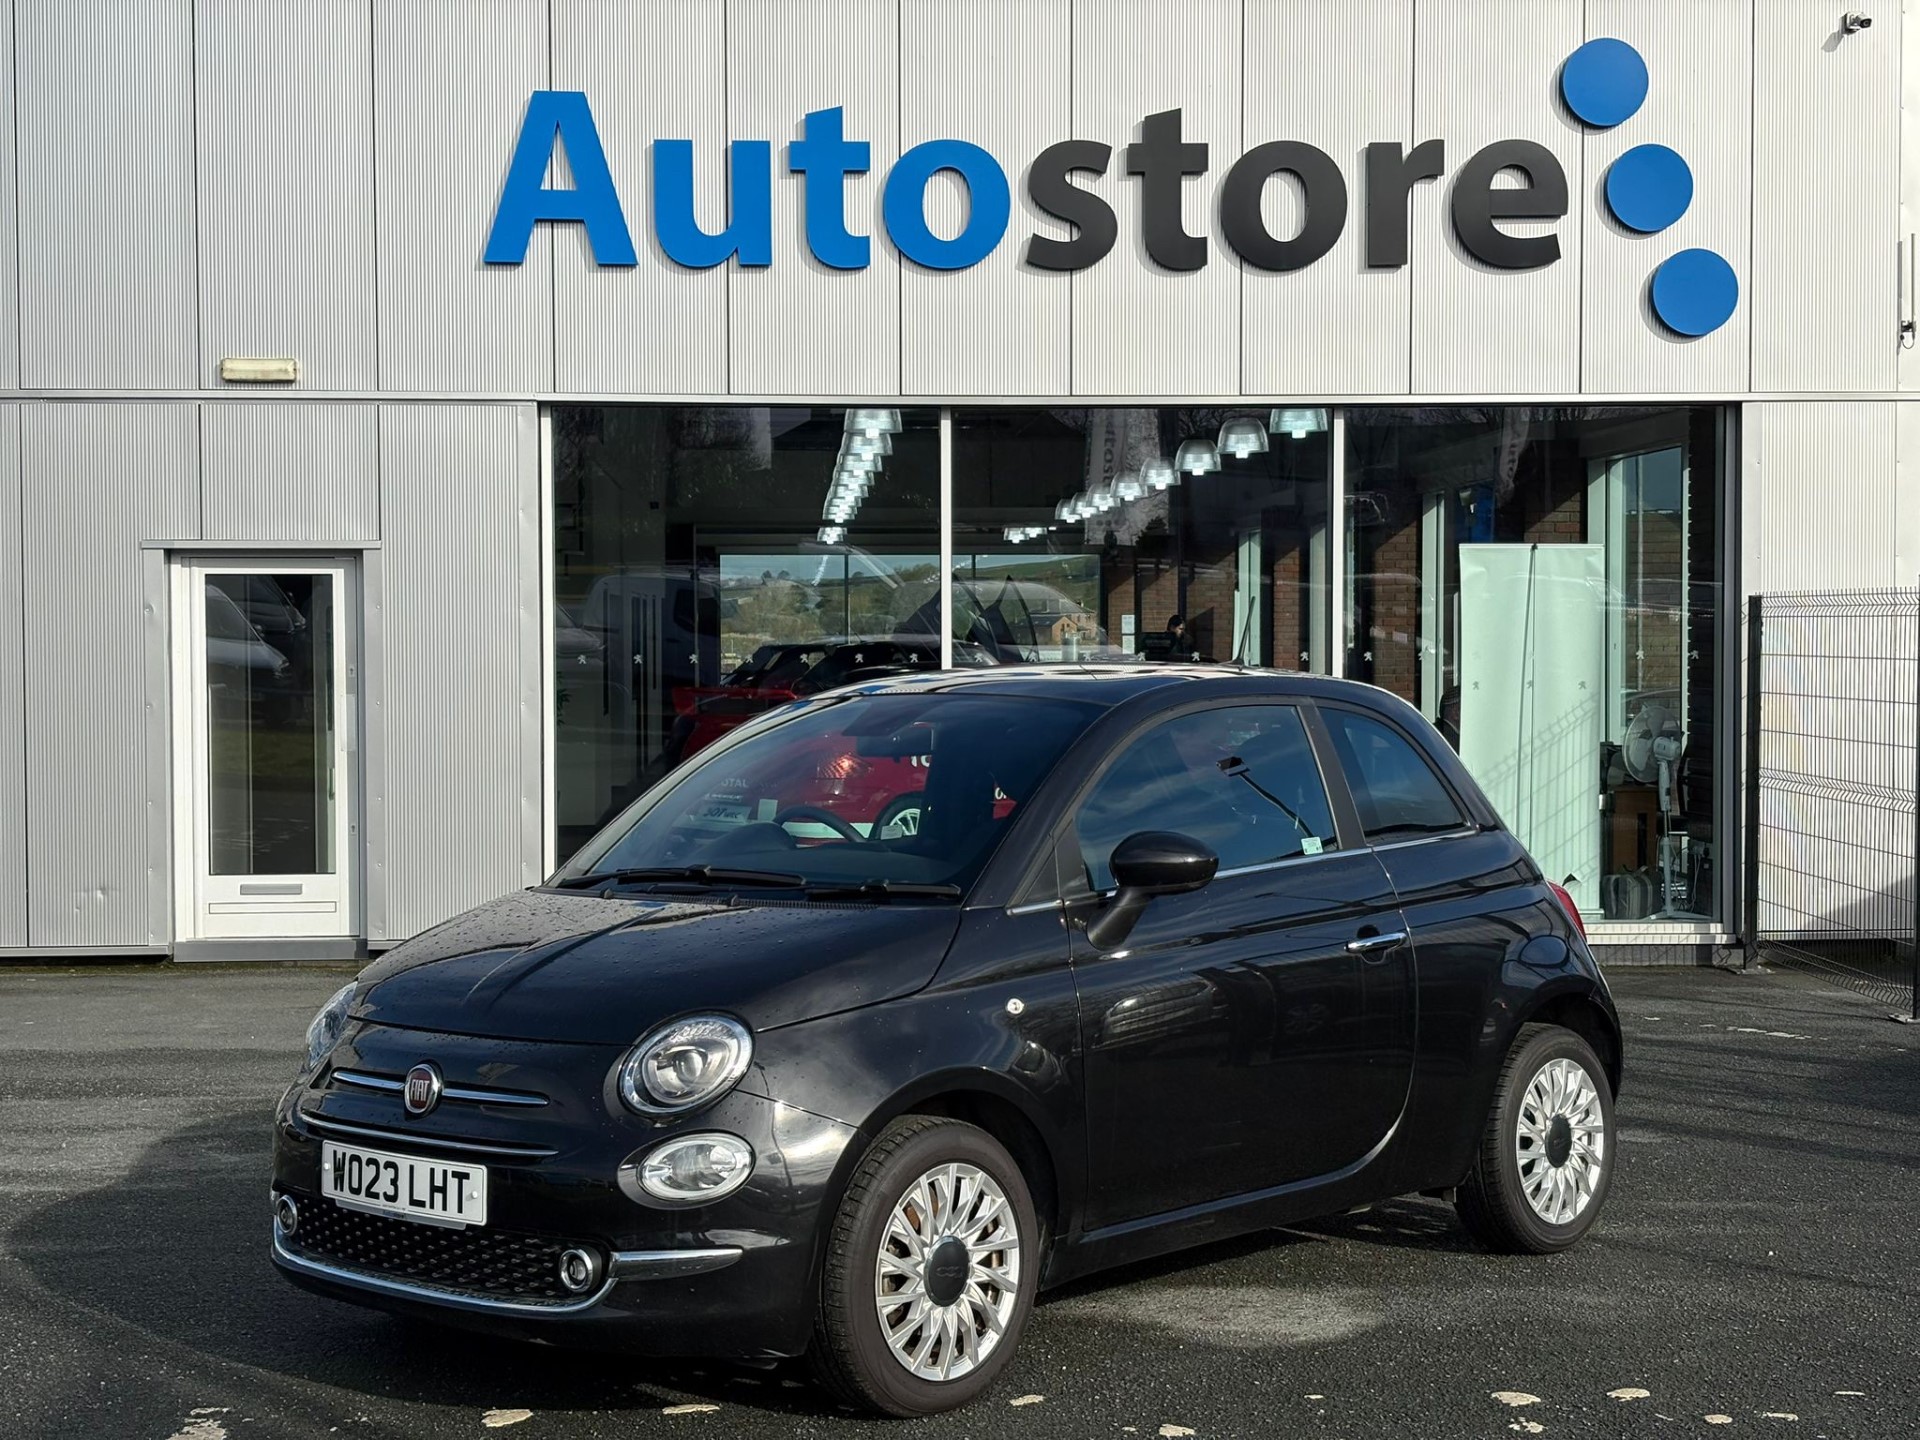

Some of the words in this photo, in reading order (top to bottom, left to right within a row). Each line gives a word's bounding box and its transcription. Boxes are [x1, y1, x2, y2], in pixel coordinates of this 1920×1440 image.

[484, 90, 1569, 271] Autostore
[410, 1079, 430, 1101] FIAT
[409, 1164, 470, 1214] LHT
